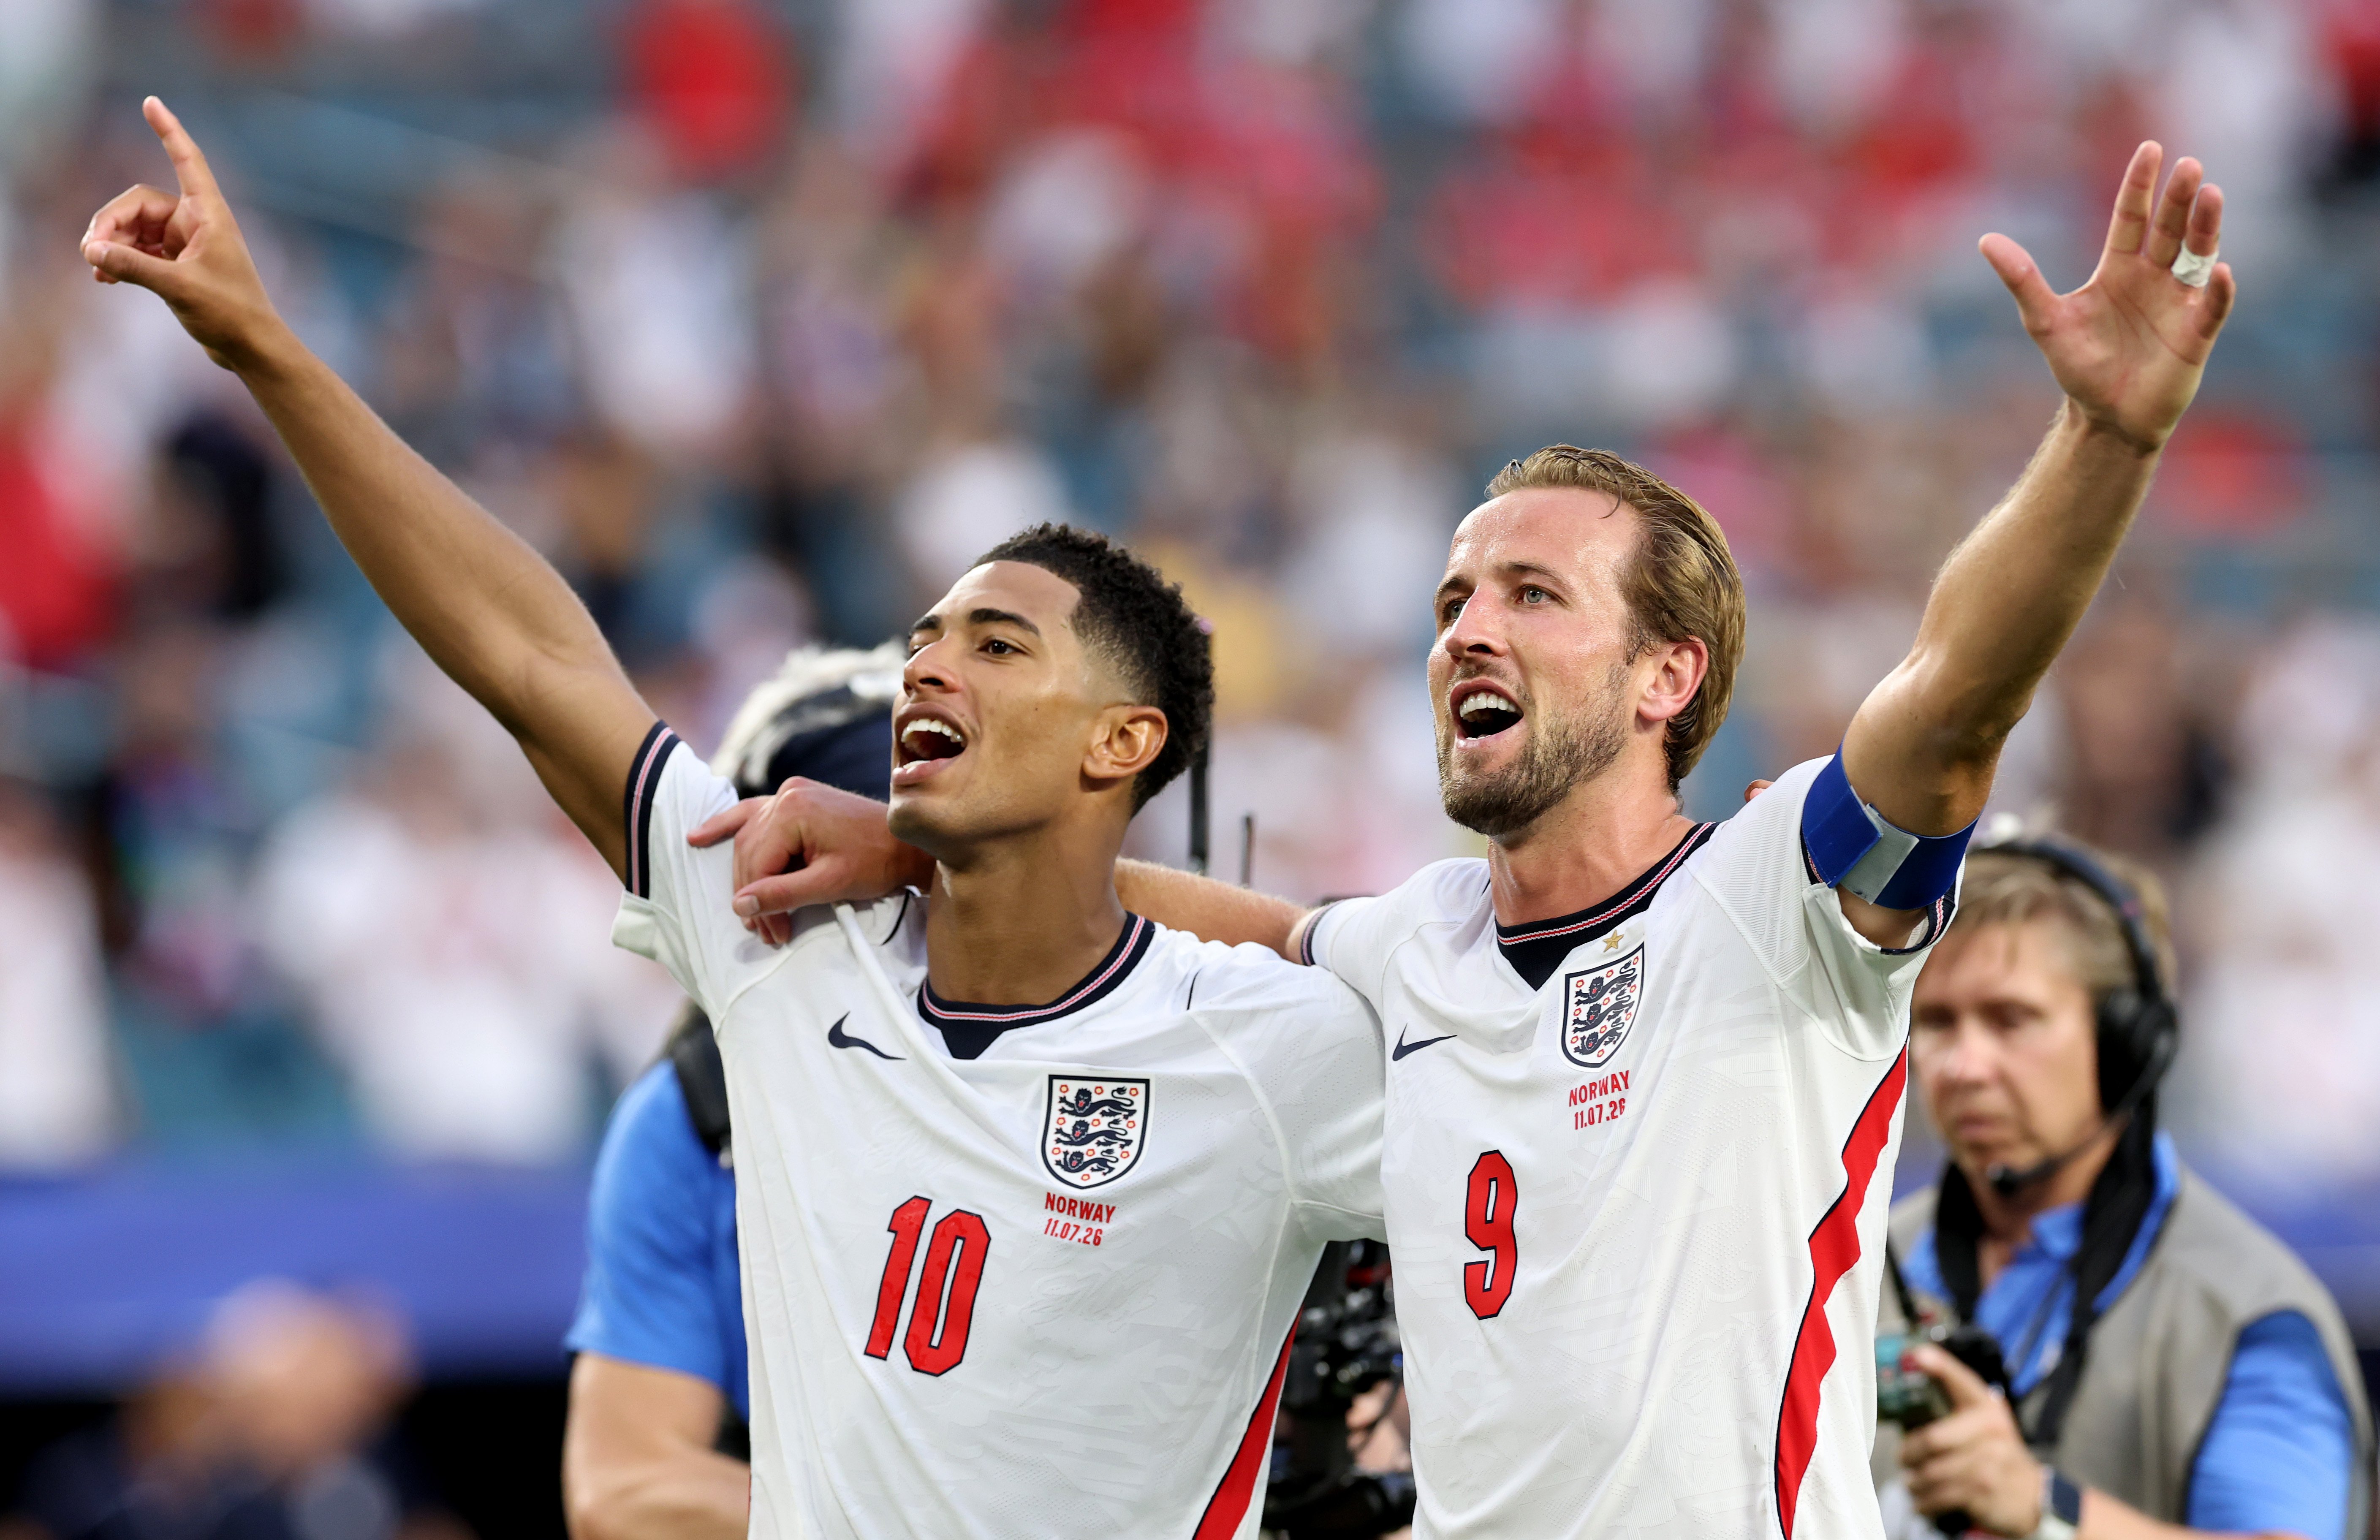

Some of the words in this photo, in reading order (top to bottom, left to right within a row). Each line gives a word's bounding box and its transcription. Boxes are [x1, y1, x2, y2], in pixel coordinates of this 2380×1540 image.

[1569, 1070, 1629, 1107] NORWAY
[1574, 1098, 1626, 1130] 11.07.26
[1045, 1192, 1116, 1224] NORWAY
[1044, 1218, 1103, 1247] 11.07.26
[1464, 1149, 1518, 1320] 9
[864, 1195, 991, 1377] 10
